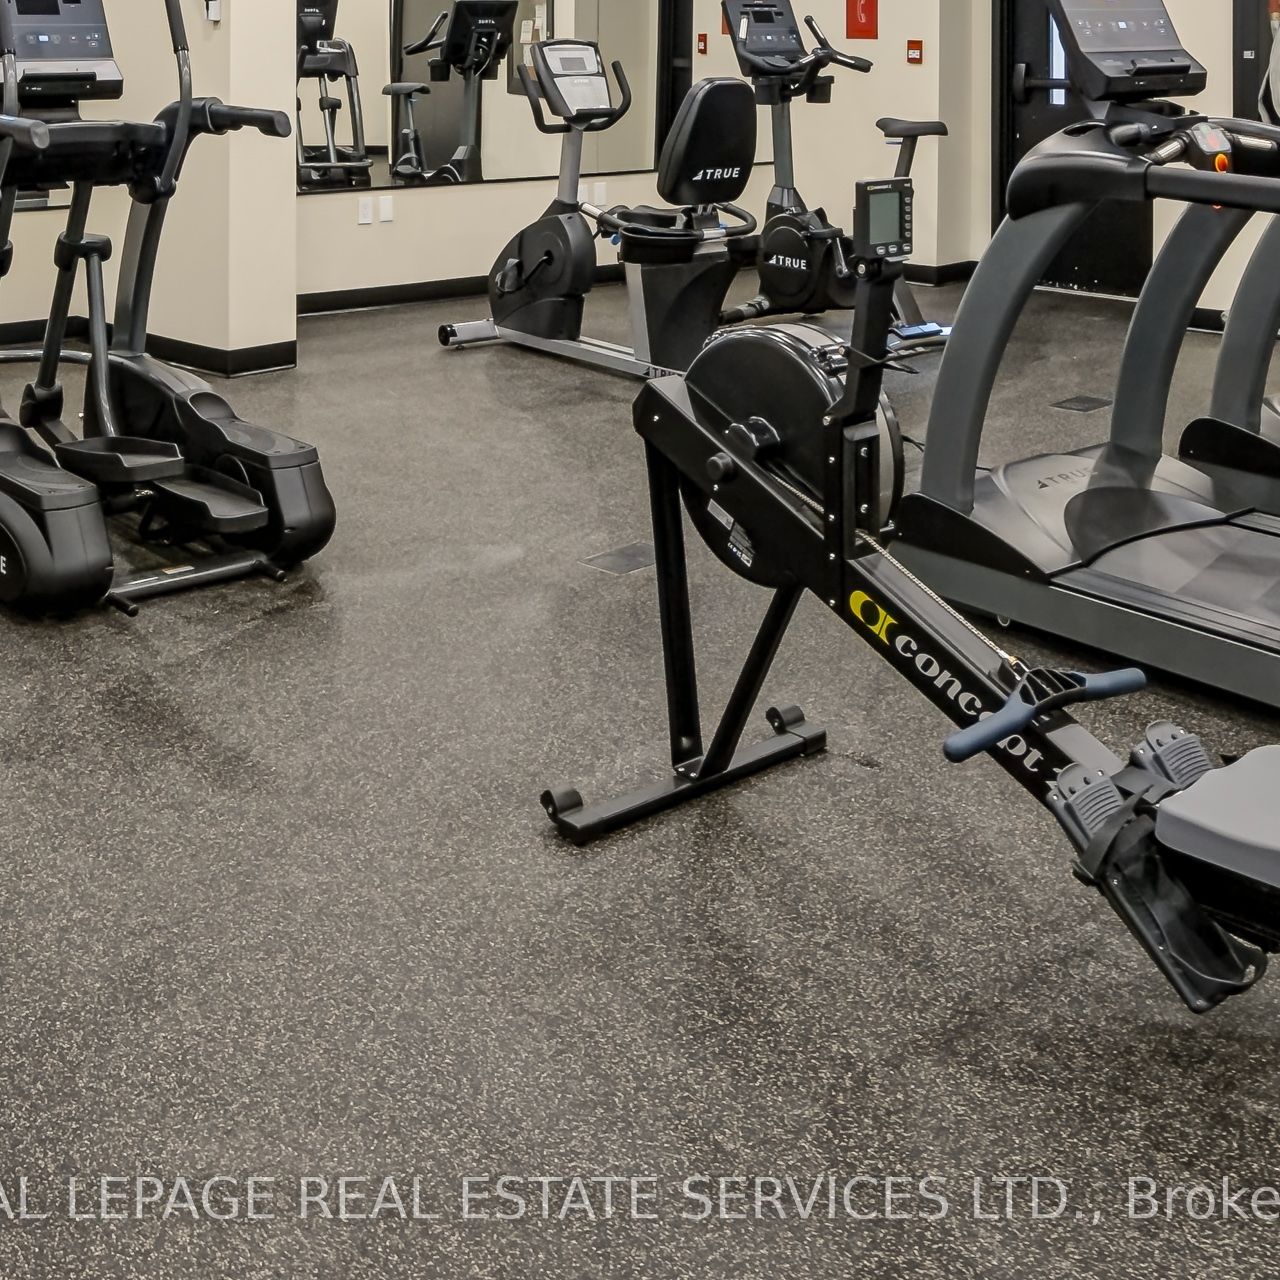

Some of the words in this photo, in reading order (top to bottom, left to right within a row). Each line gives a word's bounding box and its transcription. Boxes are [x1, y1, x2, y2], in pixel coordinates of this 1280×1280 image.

[705, 167, 741, 180] TRUE
[777, 255, 807, 270] TRUE
[894, 634, 1045, 773] concpt
